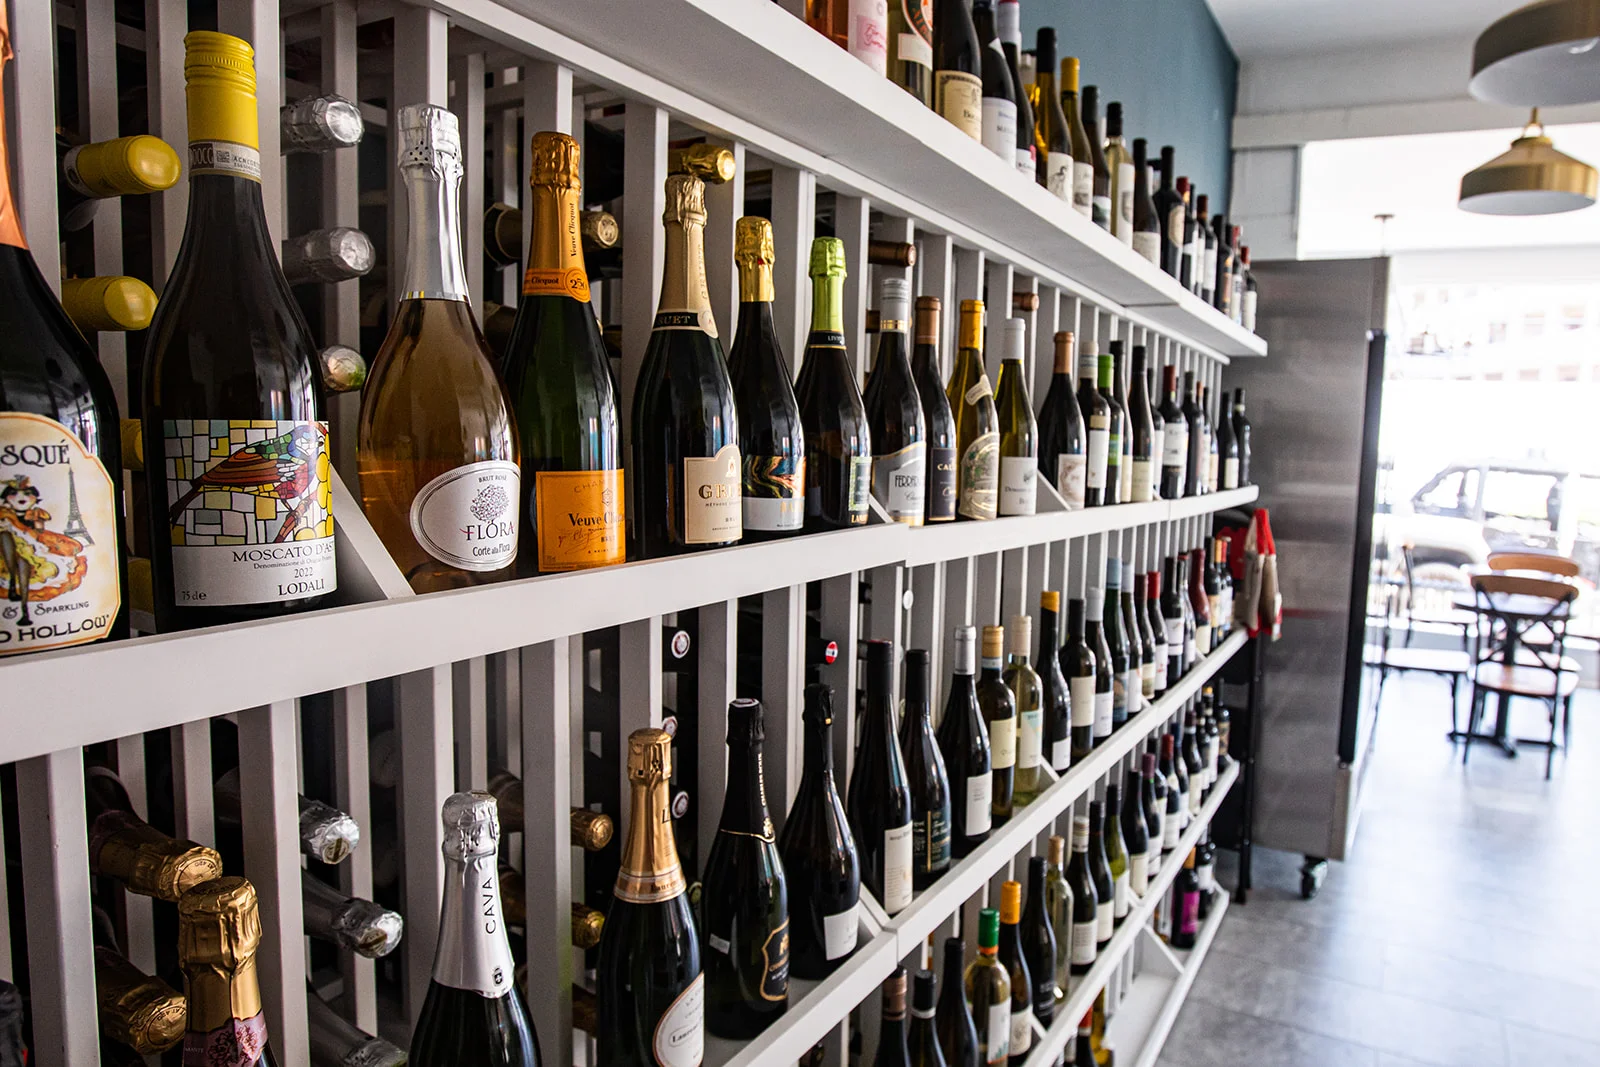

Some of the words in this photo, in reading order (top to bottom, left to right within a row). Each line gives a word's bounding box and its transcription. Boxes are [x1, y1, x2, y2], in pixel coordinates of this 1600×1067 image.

[568, 512, 602, 527] Veuve
[459, 521, 515, 541] FLORA
[232, 546, 313, 563] MOSCATO
[472, 546, 491, 557] Corte
[253, 557, 299, 569] Denominazione
[294, 567, 313, 579] 2022
[278, 578, 325, 596] LODALI
[2, 606, 19, 620] &
[483, 877, 496, 935] CAVA
